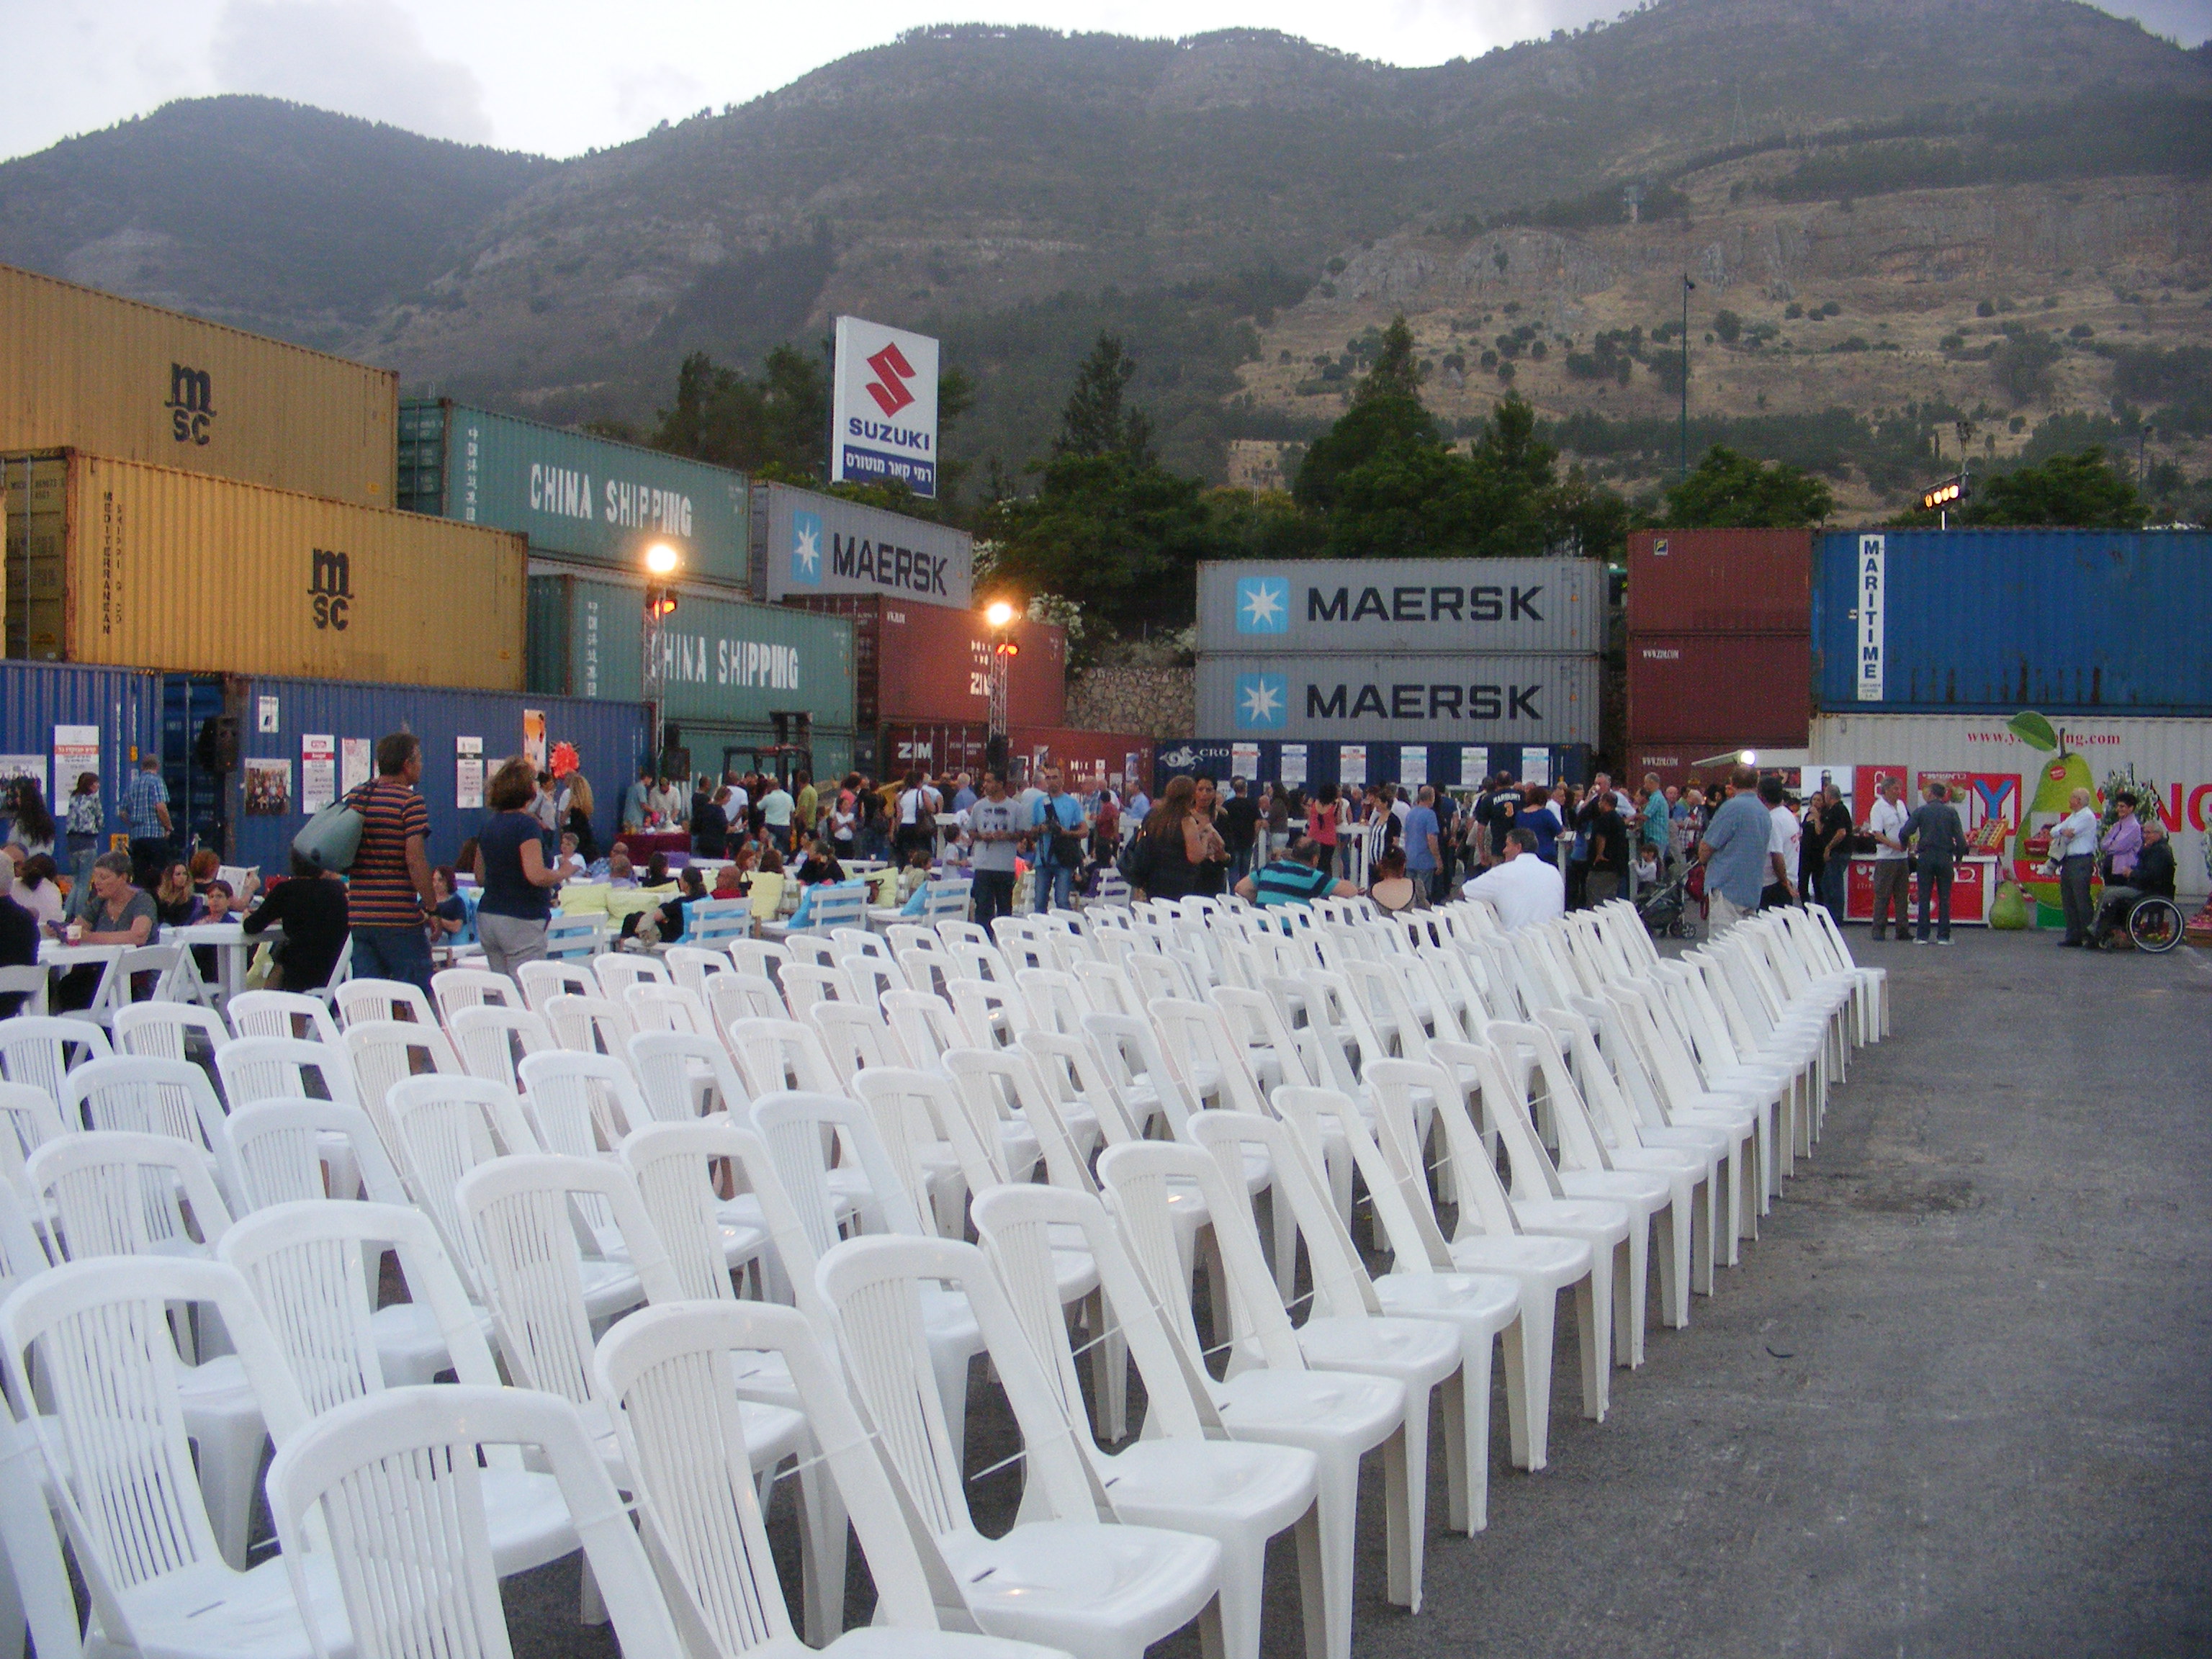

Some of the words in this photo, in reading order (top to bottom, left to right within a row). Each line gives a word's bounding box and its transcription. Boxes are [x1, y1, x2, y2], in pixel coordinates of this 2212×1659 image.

[849, 417, 930, 451] SUZUKI
[845, 453, 885, 474] מוטורס
[888, 461, 911, 482] קאר
[914, 465, 932, 483] רמי
[530, 463, 593, 520] CHINA
[606, 479, 692, 537] SHIPPING
[833, 532, 948, 596] MAERSK
[1308, 585, 1545, 621] MAERSK
[1863, 540, 1879, 679] MARITIME
[719, 638, 799, 691] SHIPPING
[1306, 683, 1544, 719] MAERSK
[898, 742, 932, 759] ZIM
